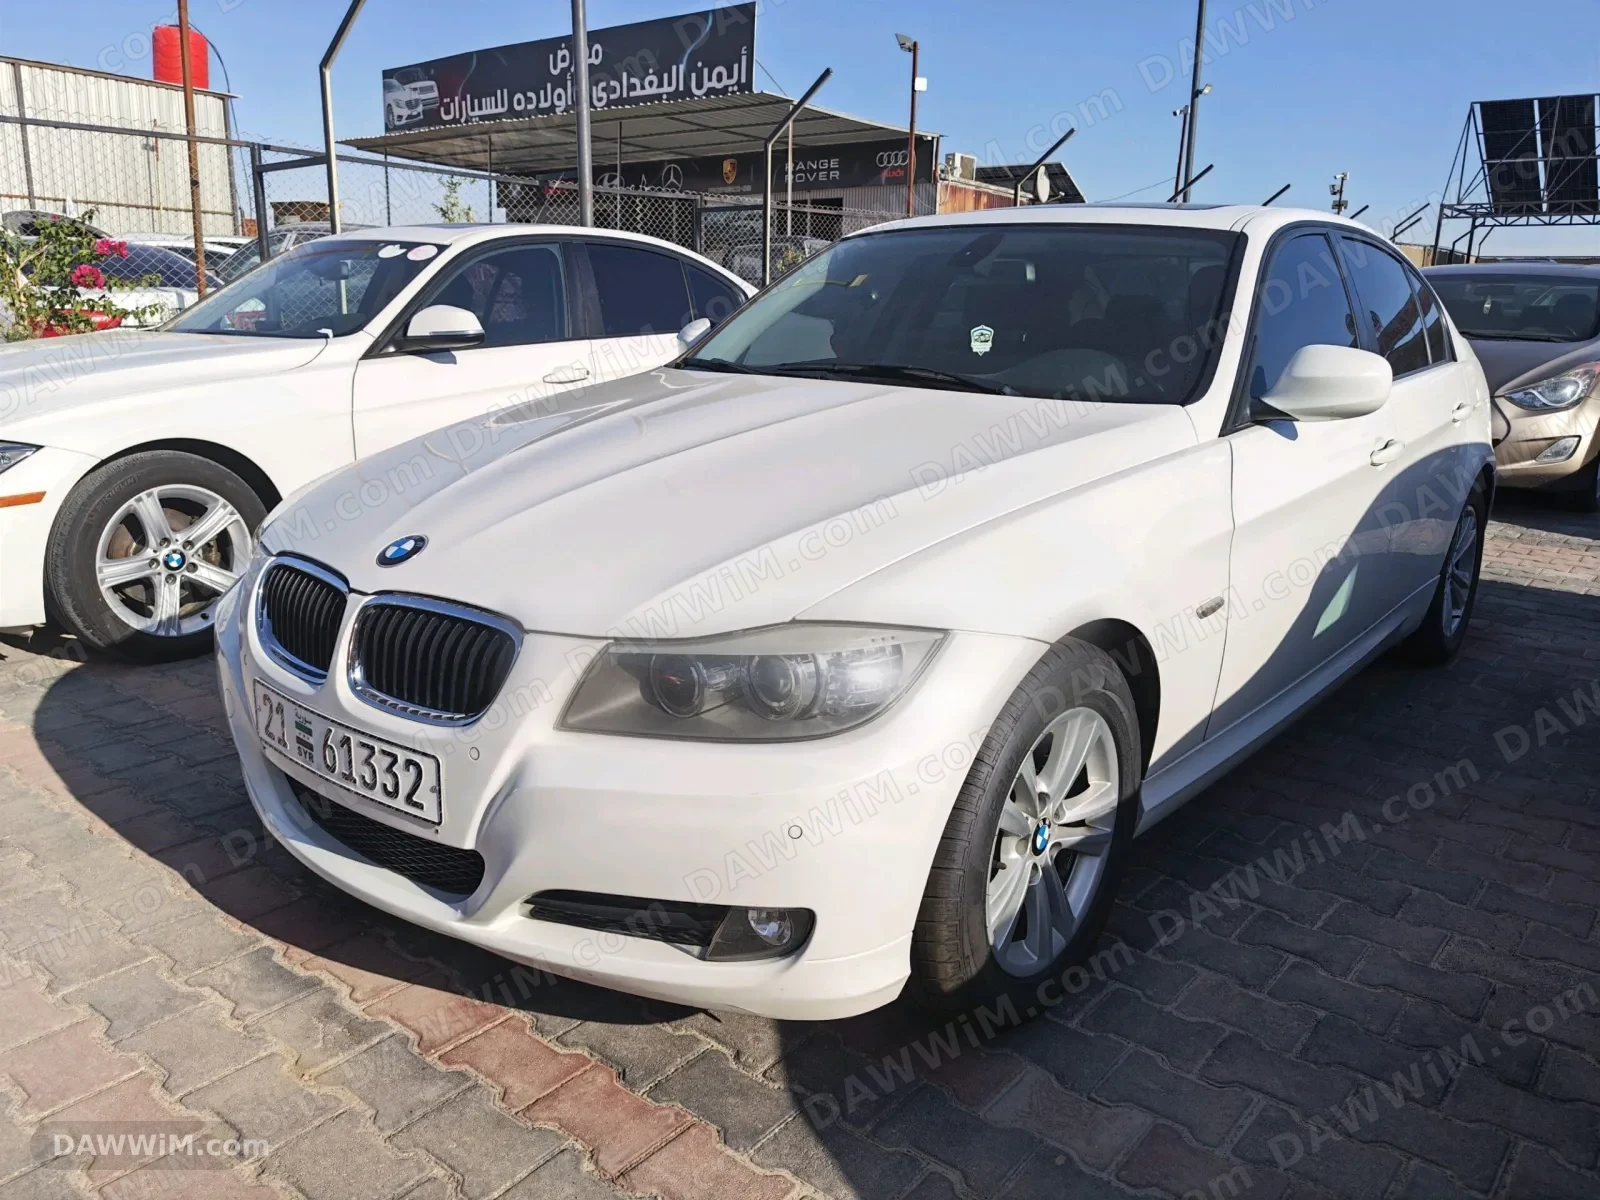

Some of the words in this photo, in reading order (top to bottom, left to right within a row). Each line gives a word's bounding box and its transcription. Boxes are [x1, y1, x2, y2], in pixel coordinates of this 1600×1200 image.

[550, 43, 602, 75] مض
[690, 46, 748, 97] أيمن
[440, 88, 509, 123] للسيارات
[513, 72, 577, 114] أولاده
[262, 693, 290, 750] 21
[322, 727, 426, 811] 61332
[297, 745, 315, 764] SYR
